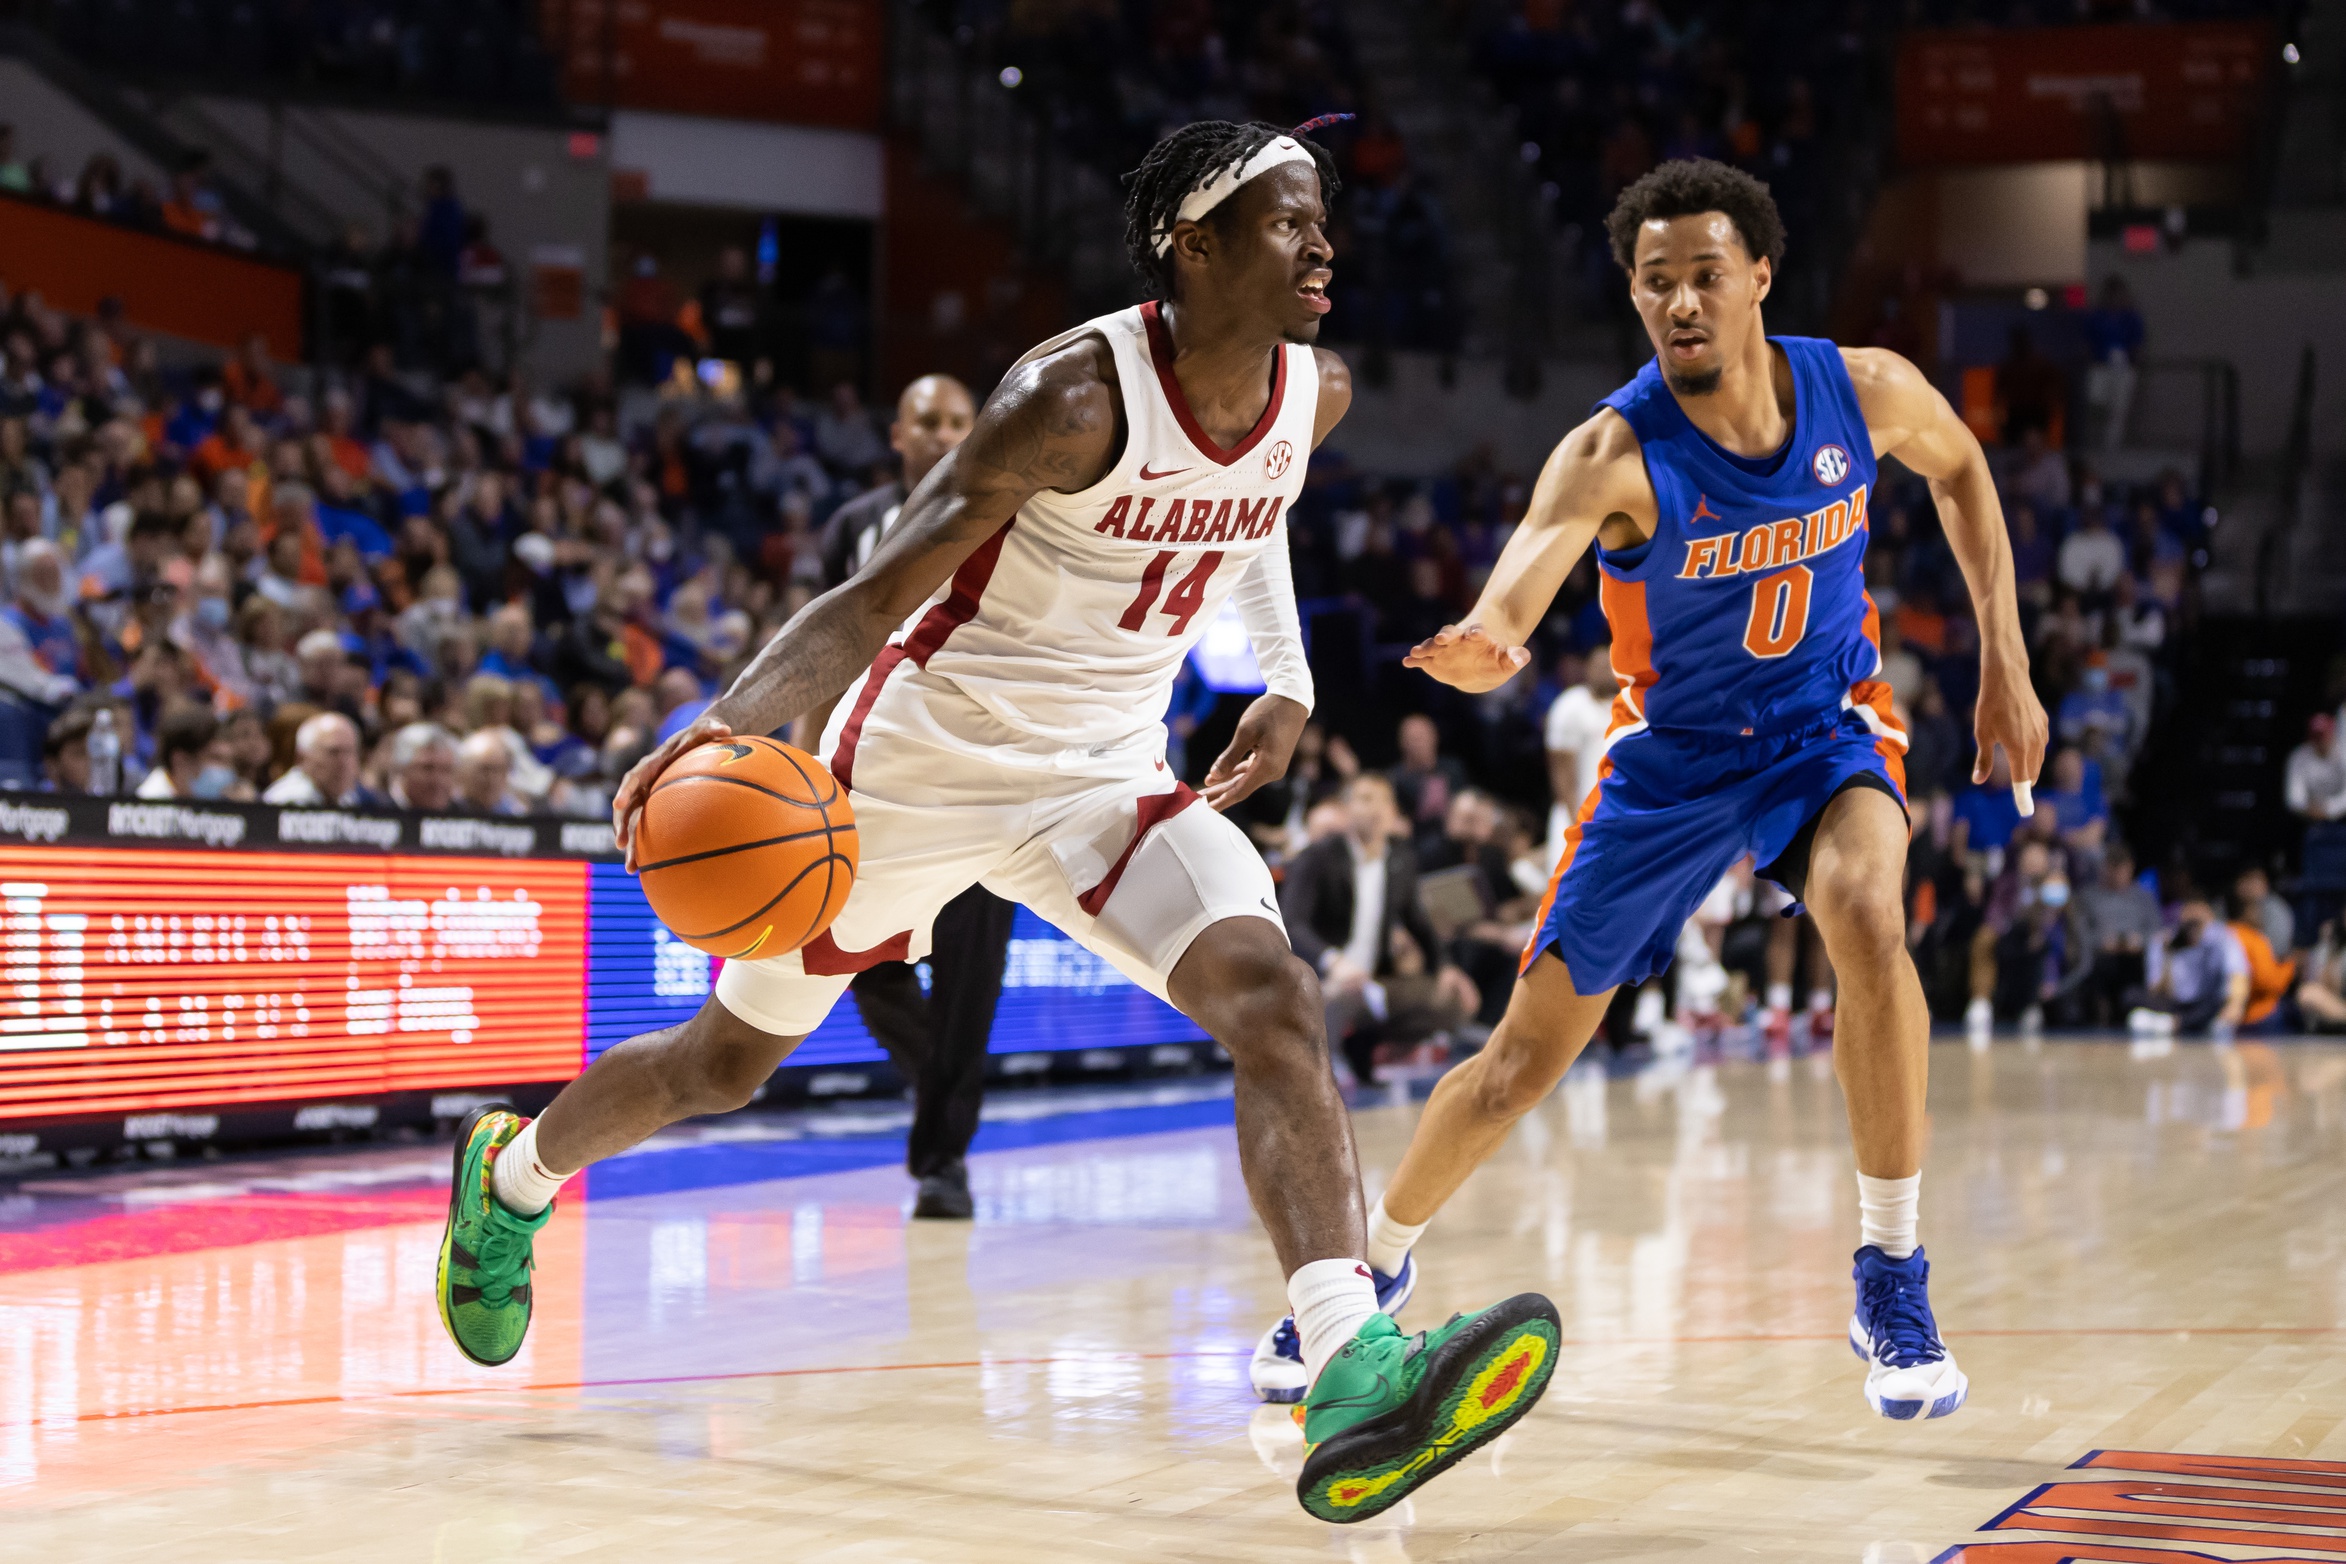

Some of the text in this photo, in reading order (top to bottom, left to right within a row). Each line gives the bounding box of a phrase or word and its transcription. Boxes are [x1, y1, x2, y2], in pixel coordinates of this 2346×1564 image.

[1267, 442, 1292, 478] SEC
[1816, 447, 1847, 483] SEC
[1094, 495, 1285, 542] ALABAMA
[1674, 484, 1867, 579] FLORIDA
[1117, 550, 1225, 636] 14
[1743, 564, 1814, 659] 0
